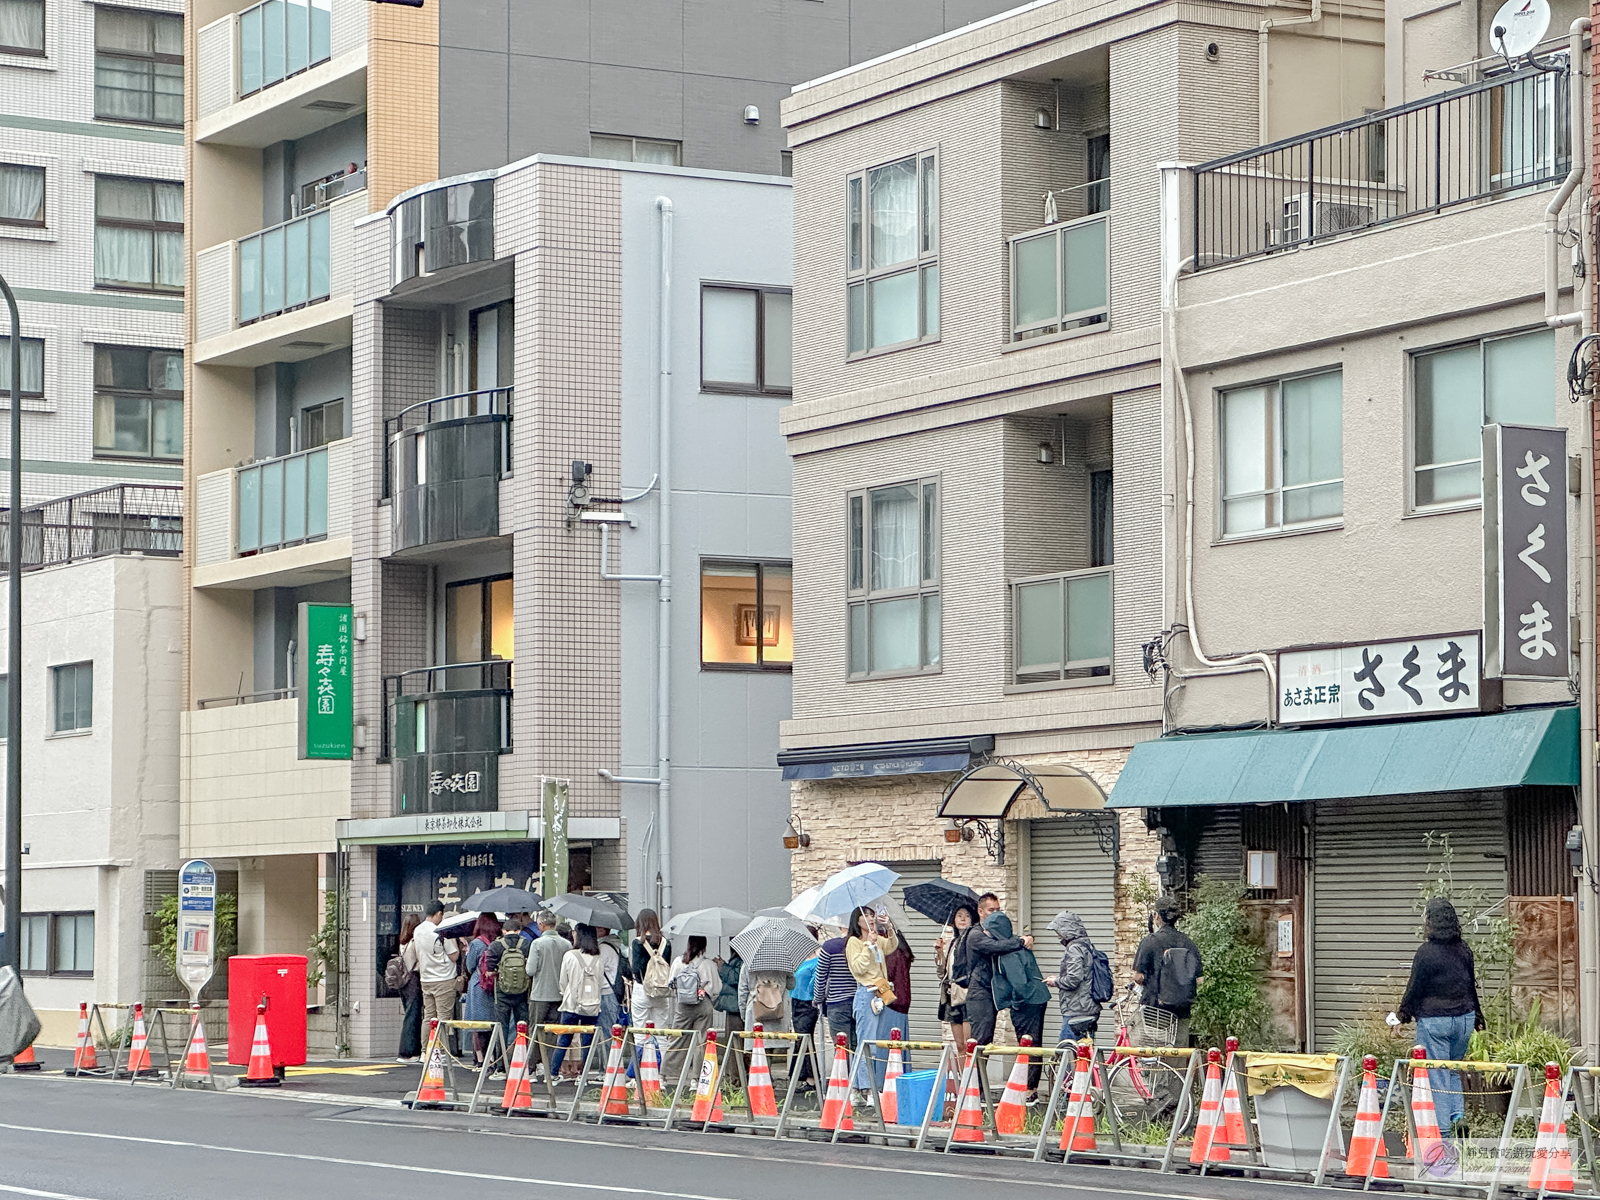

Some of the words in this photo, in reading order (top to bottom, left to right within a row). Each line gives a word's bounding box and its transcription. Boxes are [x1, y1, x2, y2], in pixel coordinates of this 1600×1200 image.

[1515, 449, 1557, 661] さくま
[1283, 683, 1341, 707] あさま正宗
[1353, 640, 1471, 711] さくま
